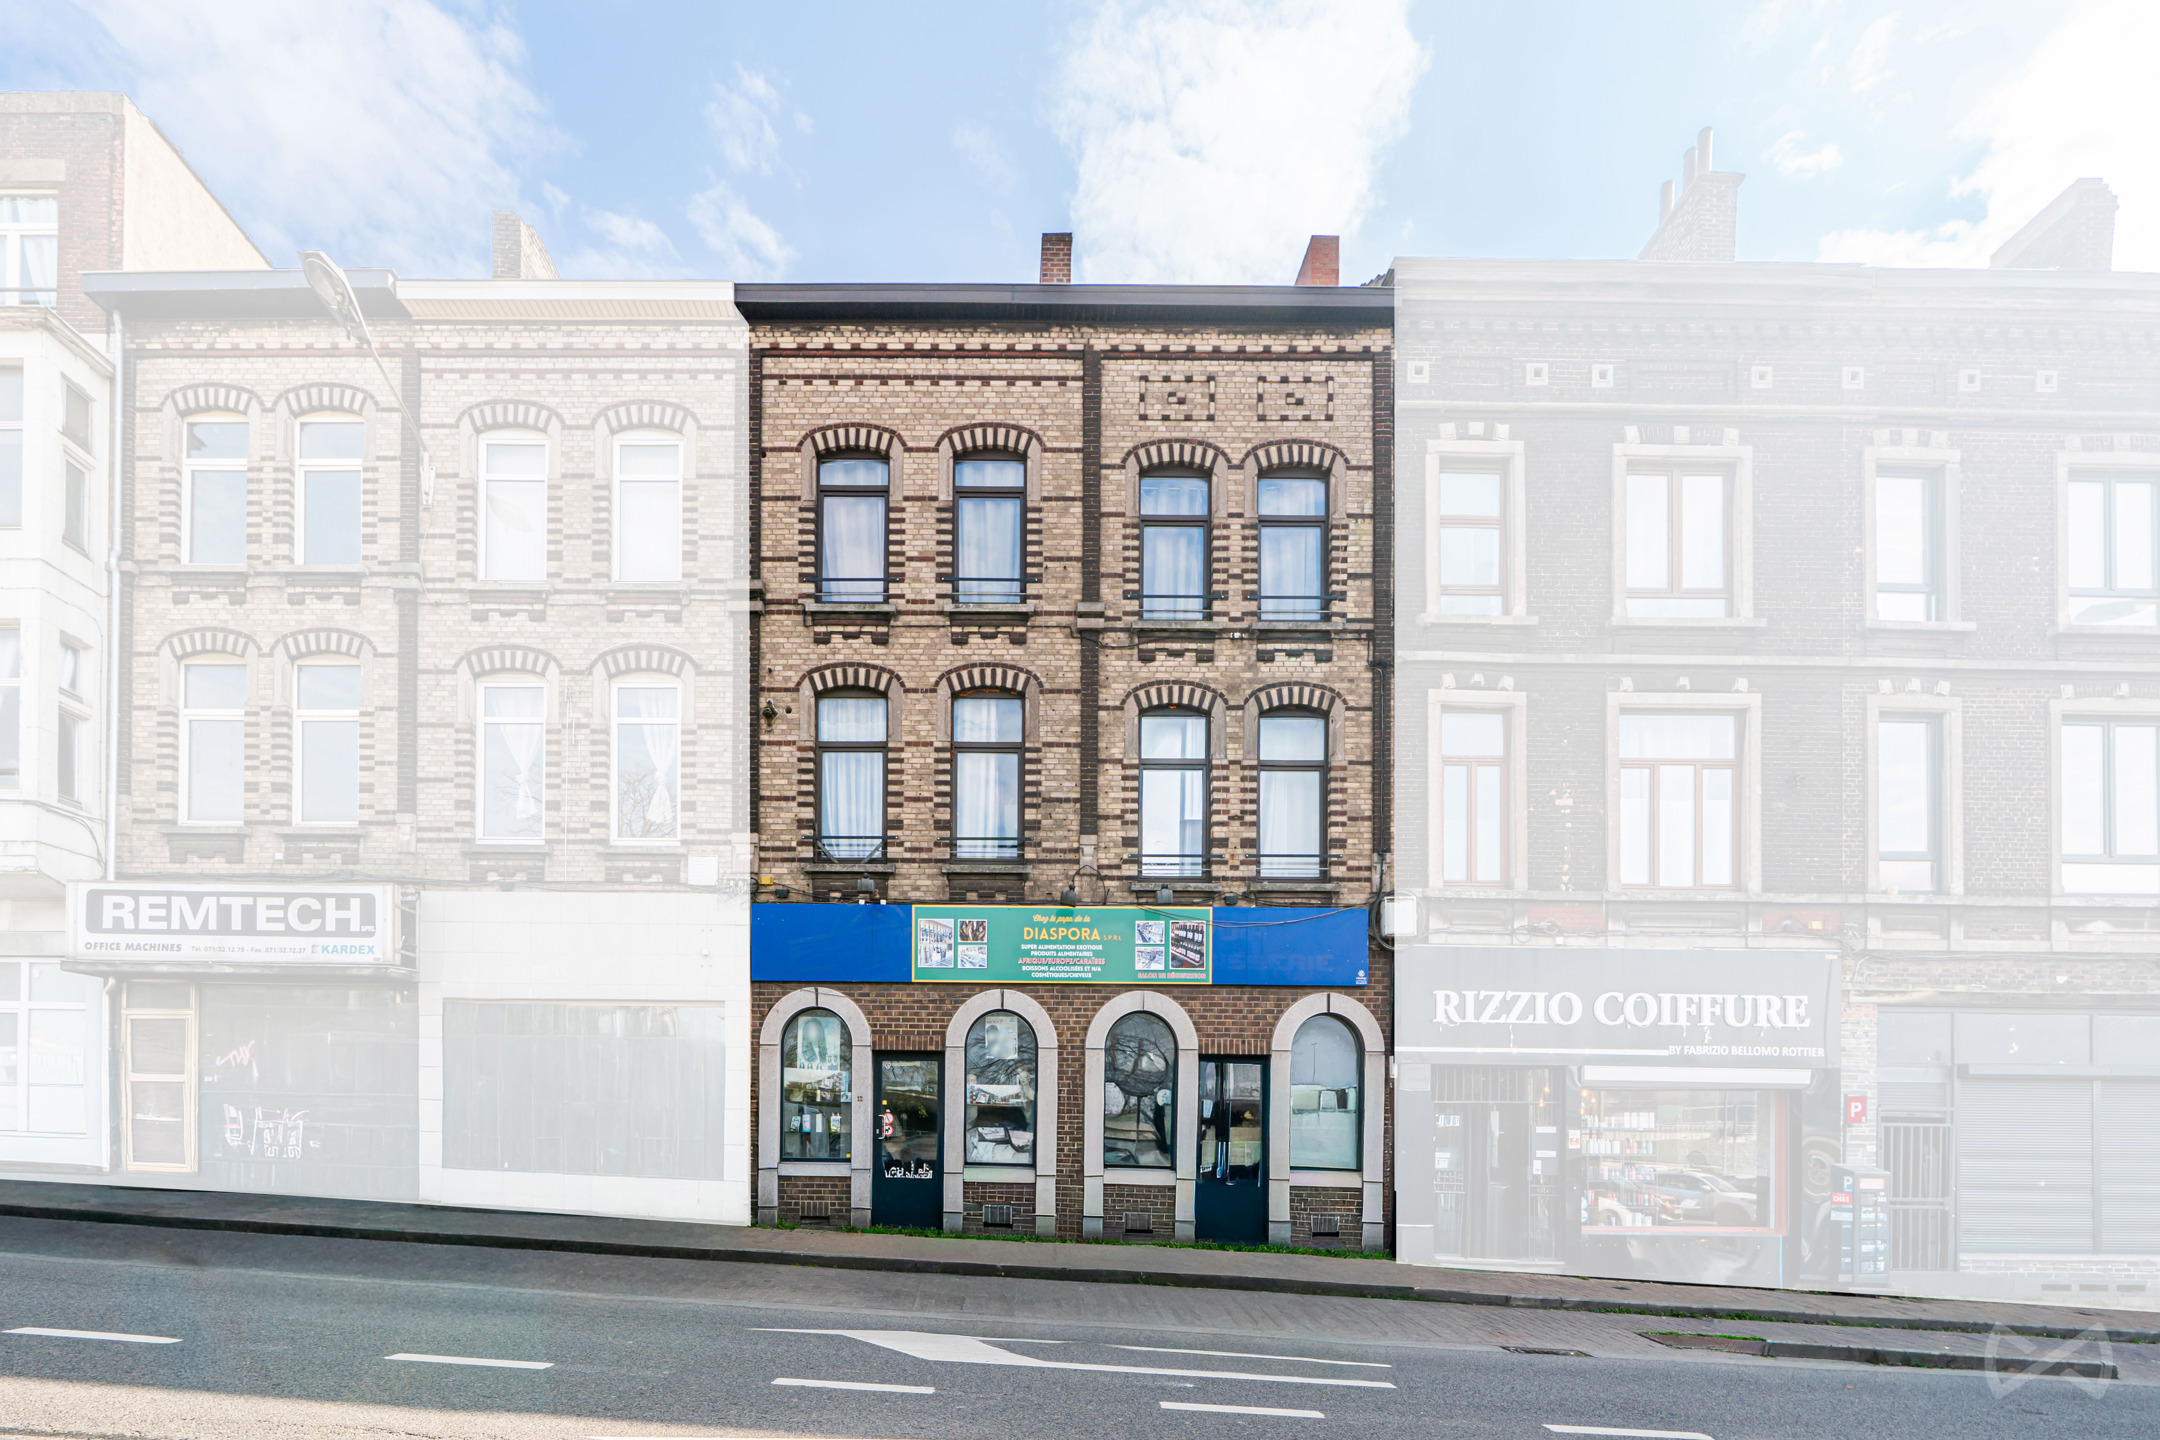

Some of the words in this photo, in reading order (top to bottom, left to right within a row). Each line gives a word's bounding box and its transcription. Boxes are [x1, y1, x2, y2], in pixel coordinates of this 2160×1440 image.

[102, 895, 360, 932] REMTECH
[1023, 927, 1101, 941] DIASPORA
[84, 941, 121, 952] OFFICE
[124, 942, 182, 953] MACHINES
[321, 944, 375, 955] KARDEX
[1432, 989, 1584, 1026] RIZZIO
[1592, 990, 1811, 1029] COIFFURE
[1668, 1045, 1682, 1056] BY
[1683, 1045, 1729, 1056] FABRIZIO
[1730, 1046, 1780, 1057] BELLOMO
[1782, 1047, 1825, 1058] ROTTIER
[1850, 1102, 1862, 1118] P
[1844, 1176, 1853, 1188] P
